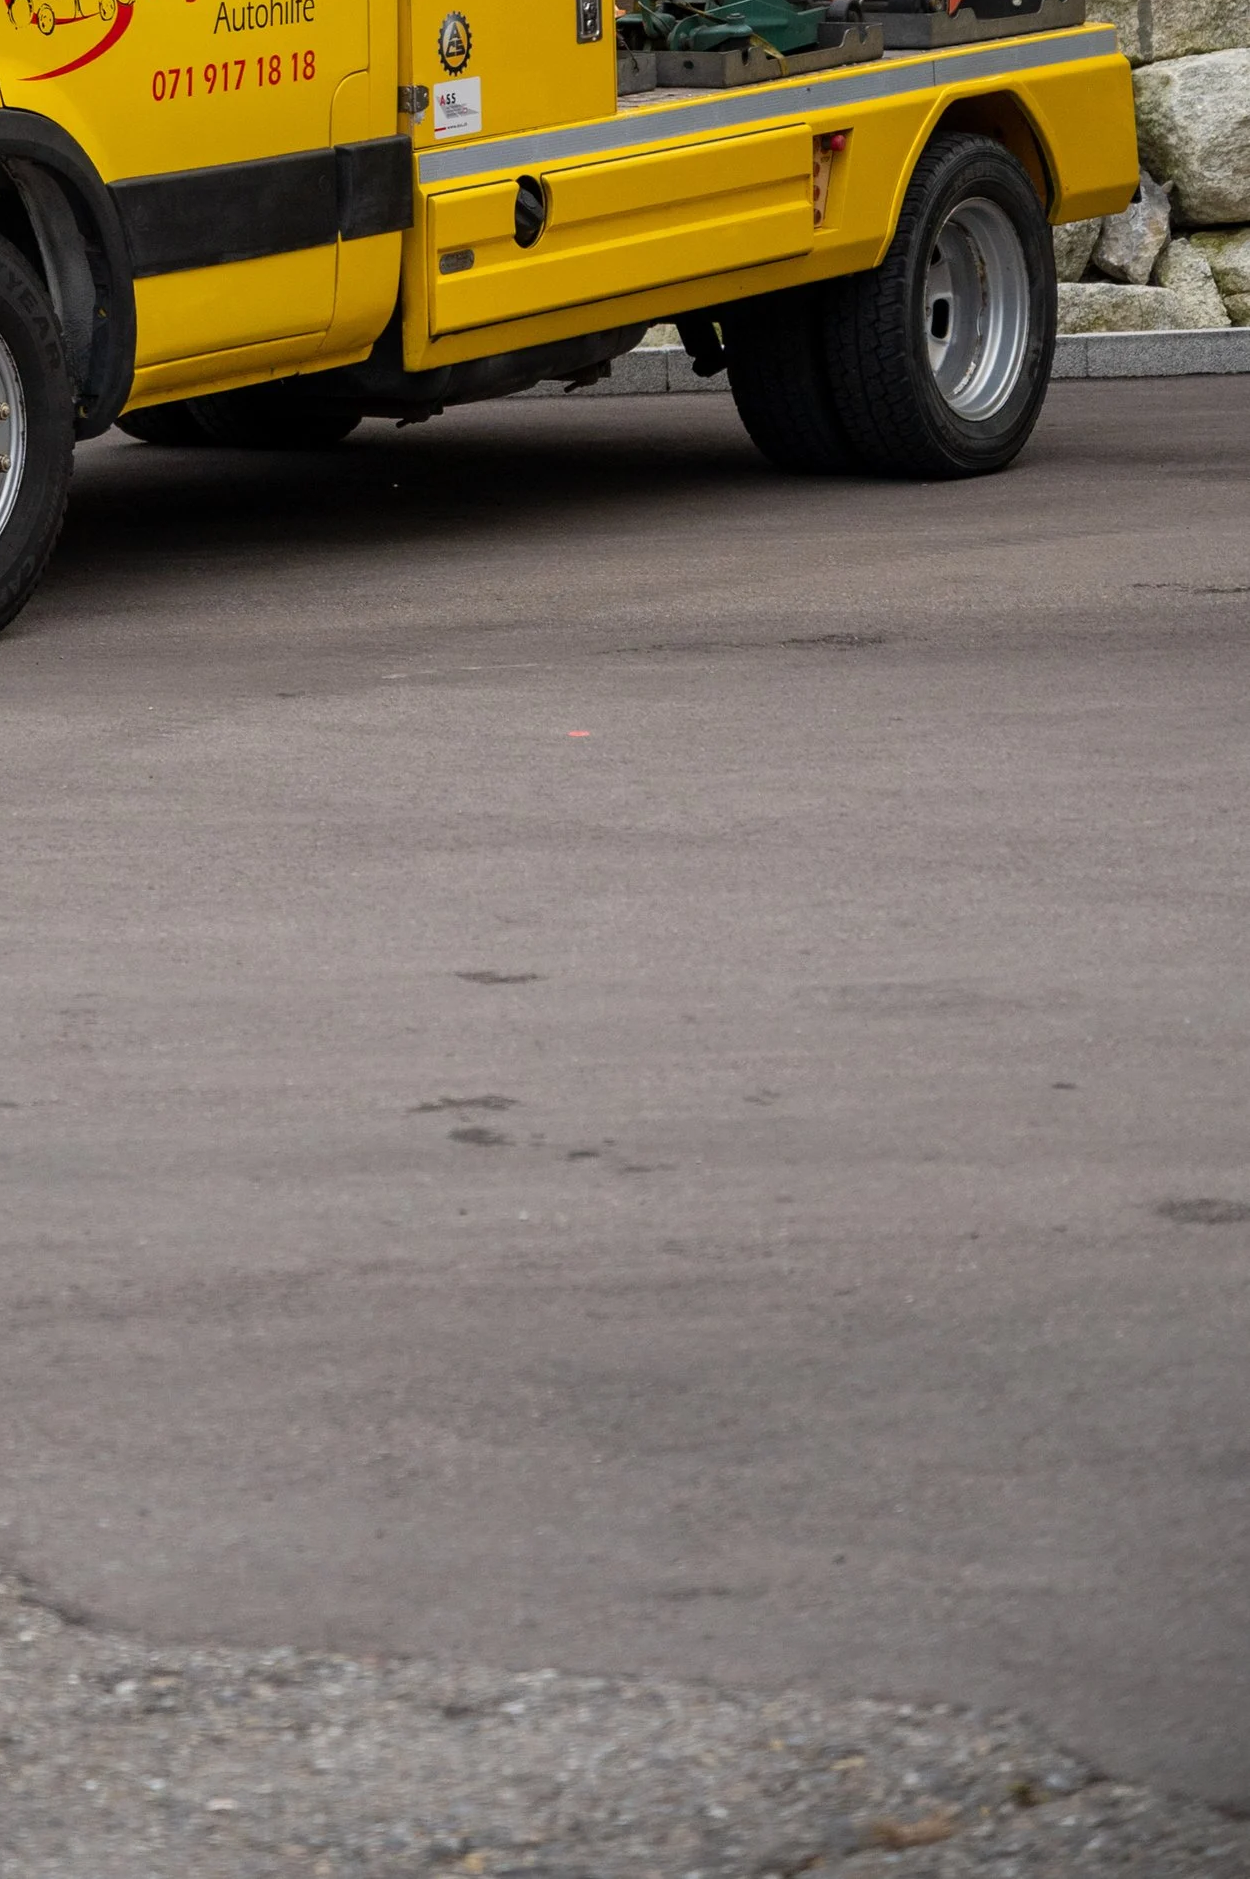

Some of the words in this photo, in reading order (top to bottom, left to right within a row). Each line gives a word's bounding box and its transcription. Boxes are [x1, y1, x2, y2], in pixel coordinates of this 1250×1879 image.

[152, 67, 193, 101] 071
[204, 60, 245, 94] 917
[257, 54, 281, 86] 18
[291, 50, 315, 82] 18
[440, 93, 456, 106] ASS
